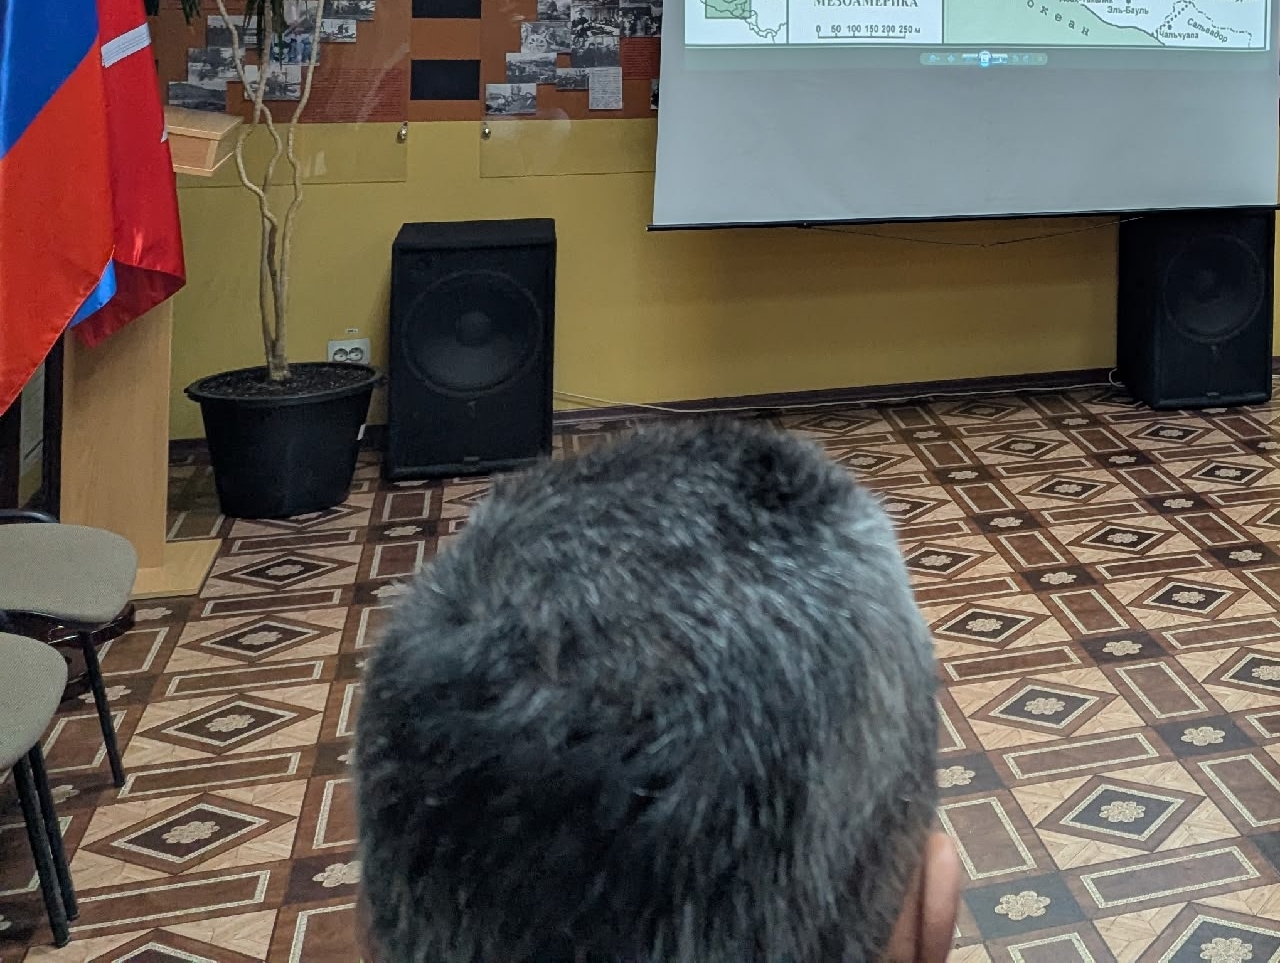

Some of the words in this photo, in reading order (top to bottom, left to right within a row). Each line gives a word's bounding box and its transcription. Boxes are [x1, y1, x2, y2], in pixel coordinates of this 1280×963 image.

[1107, 6, 1149, 16] Эль-Бауль
[816, 24, 821, 34] 0
[831, 24, 842, 34] 50
[847, 24, 862, 34] 100
[865, 24, 879, 34] 150
[881, 24, 896, 34] 200
[898, 24, 913, 34] 250
[1187, 17, 1229, 43] Сальвадор
